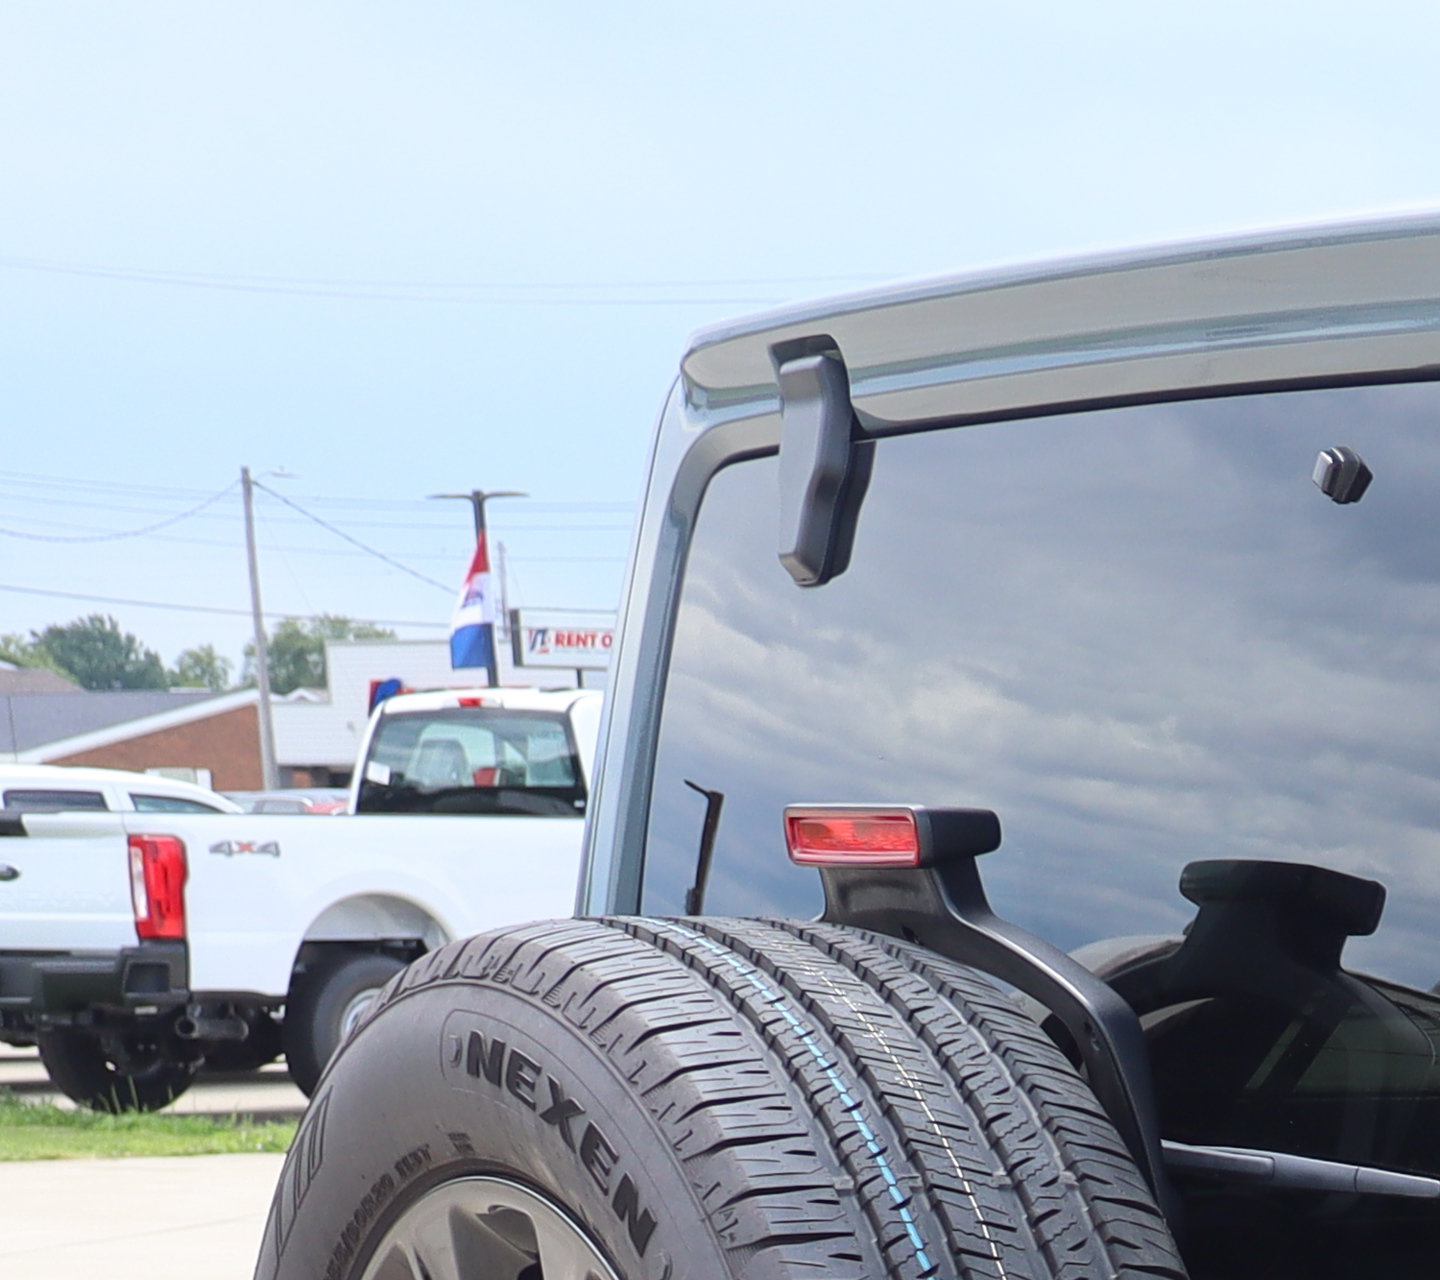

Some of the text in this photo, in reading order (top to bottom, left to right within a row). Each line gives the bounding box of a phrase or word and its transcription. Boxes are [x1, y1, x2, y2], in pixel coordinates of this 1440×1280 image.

[555, 631, 597, 648] RENT
[601, 632, 614, 648] O
[466, 1029, 658, 1258] NEXEN
